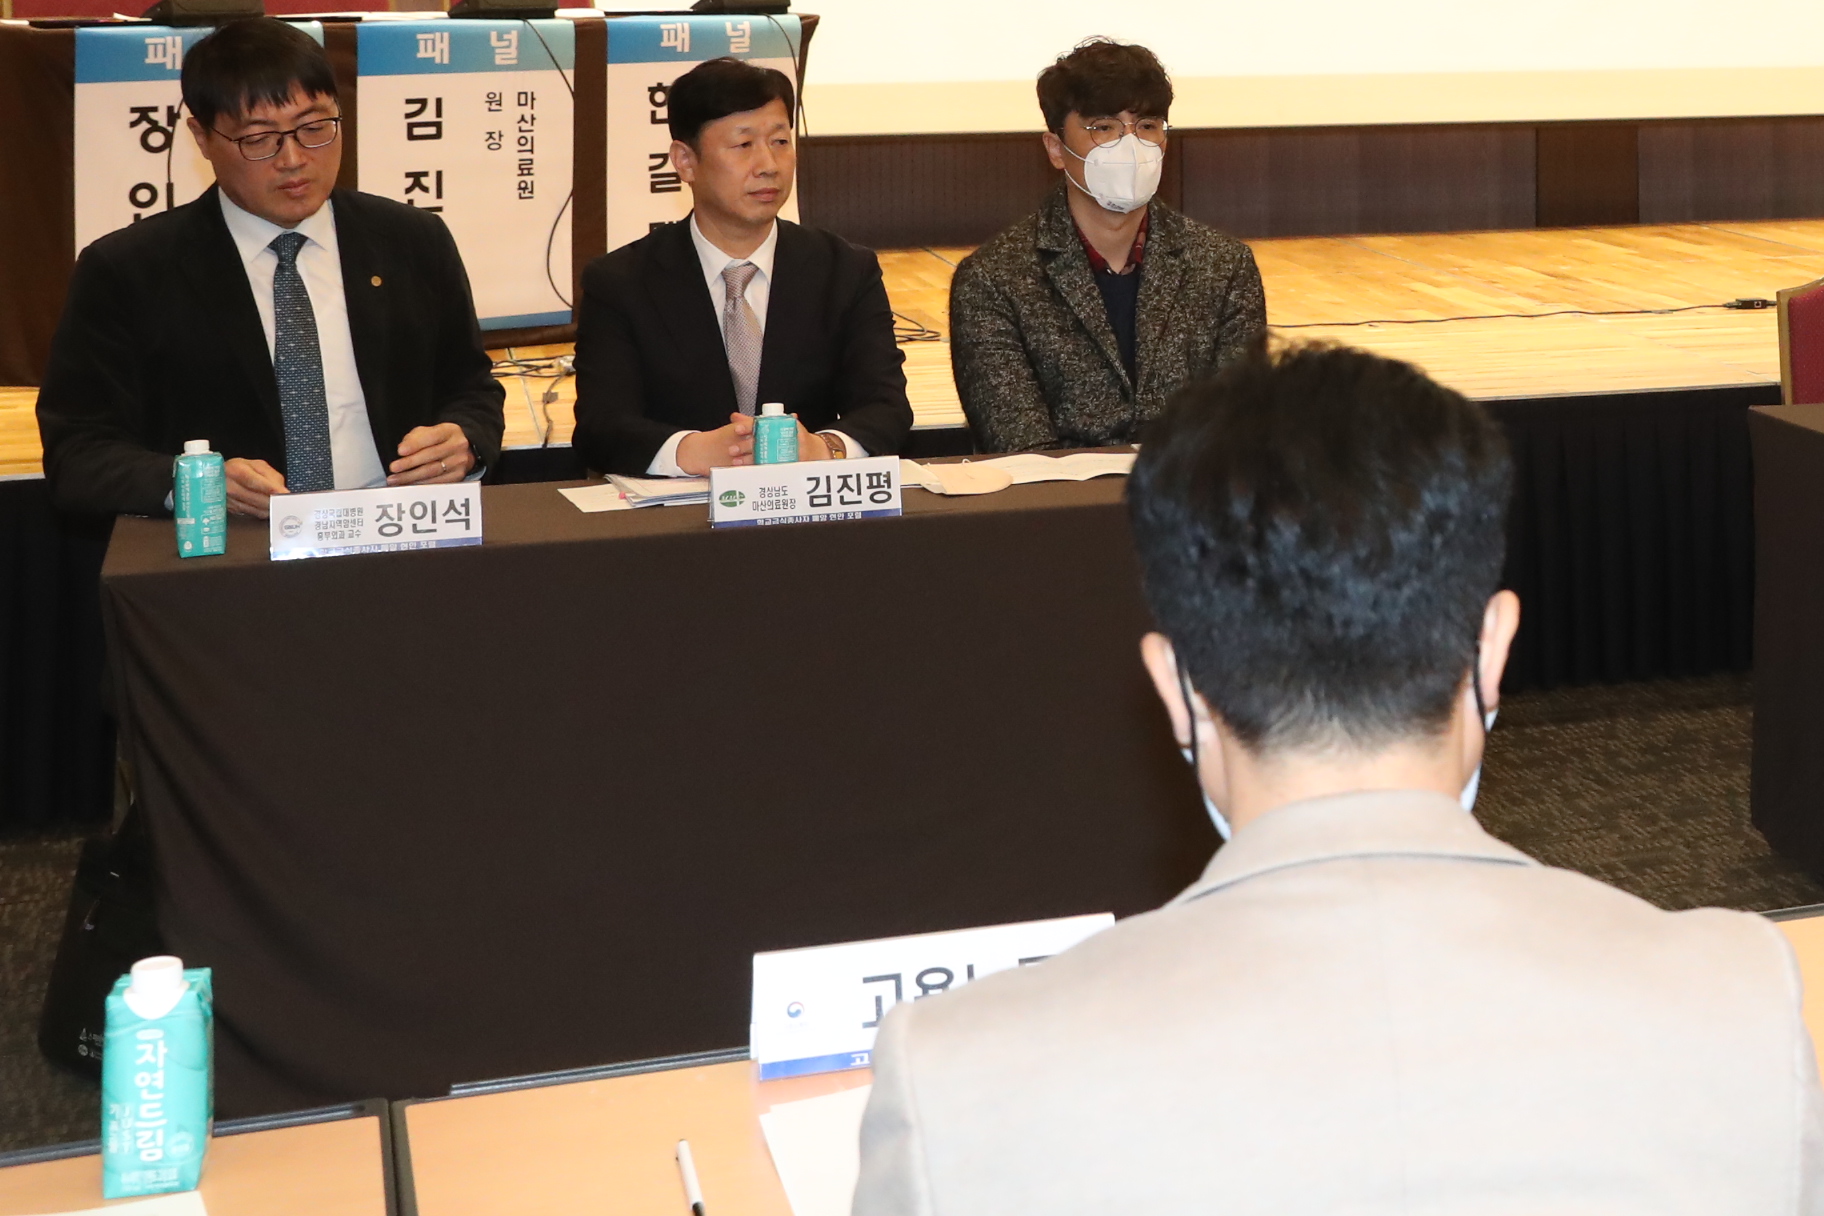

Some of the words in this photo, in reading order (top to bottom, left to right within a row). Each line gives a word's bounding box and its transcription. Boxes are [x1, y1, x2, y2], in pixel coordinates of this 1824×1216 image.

[145, 36, 183, 70] 패
[416, 30, 518, 65] 패널
[660, 20, 750, 53] 패널
[485, 91, 503, 151] 원장
[404, 97, 443, 212] 김진
[517, 91, 536, 200] 마산의료원
[129, 105, 181, 222] 장인
[752, 498, 797, 512] 마산의료원장
[758, 485, 789, 499] 경상남도
[805, 470, 893, 508] 김진평
[314, 507, 364, 520] 경상국립대병원
[315, 518, 364, 531] 경남지역암센터
[374, 497, 471, 538] 장인석
[347, 529, 362, 539] 교수
[134, 1039, 168, 1162] 자연드림
